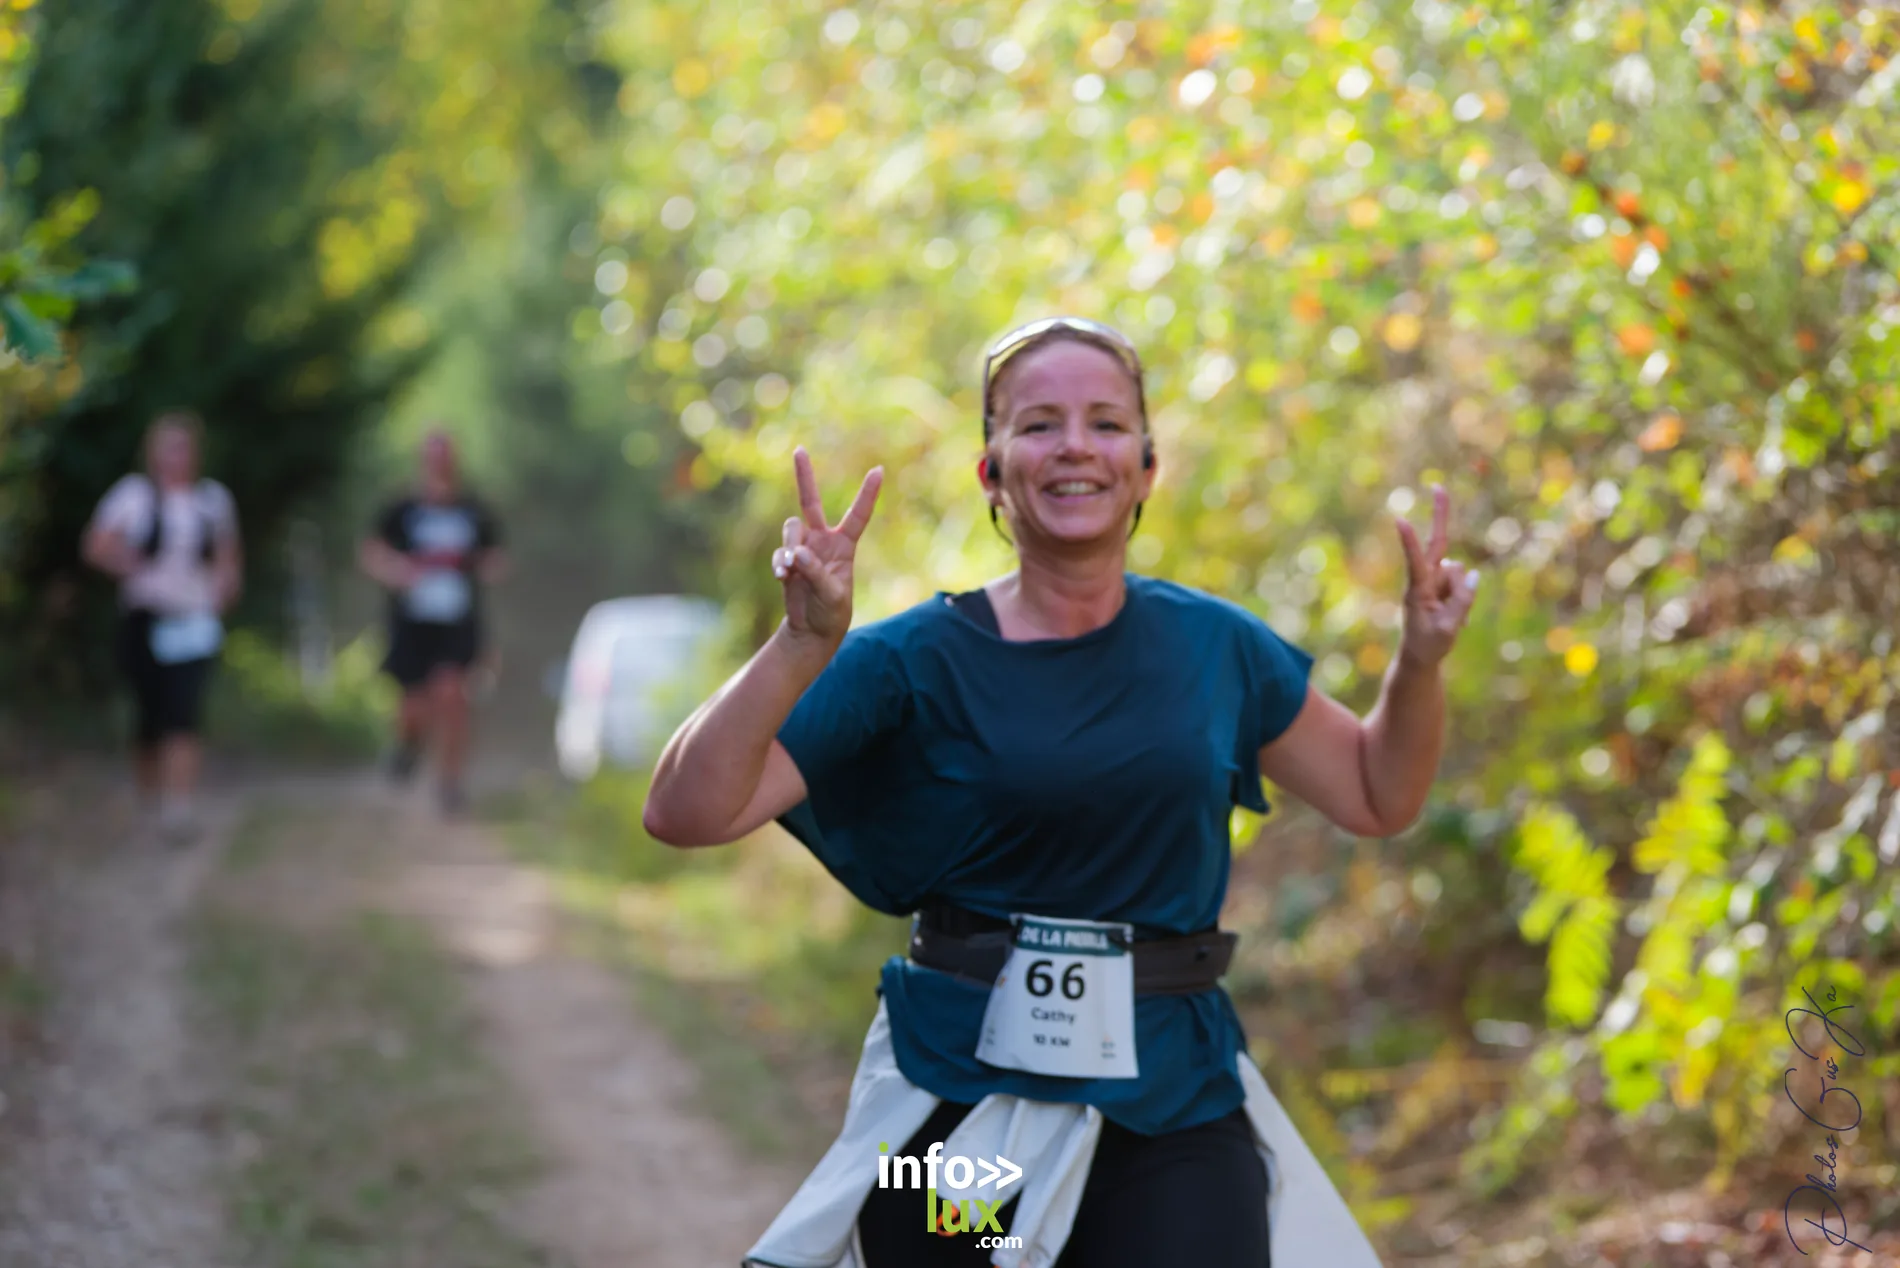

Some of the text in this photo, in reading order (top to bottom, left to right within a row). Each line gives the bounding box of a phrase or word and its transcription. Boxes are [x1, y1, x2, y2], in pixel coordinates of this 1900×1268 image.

[1041, 929, 1062, 947] LA
[1025, 958, 1086, 1001] 66
[1031, 1006, 1076, 1025] Cathy
